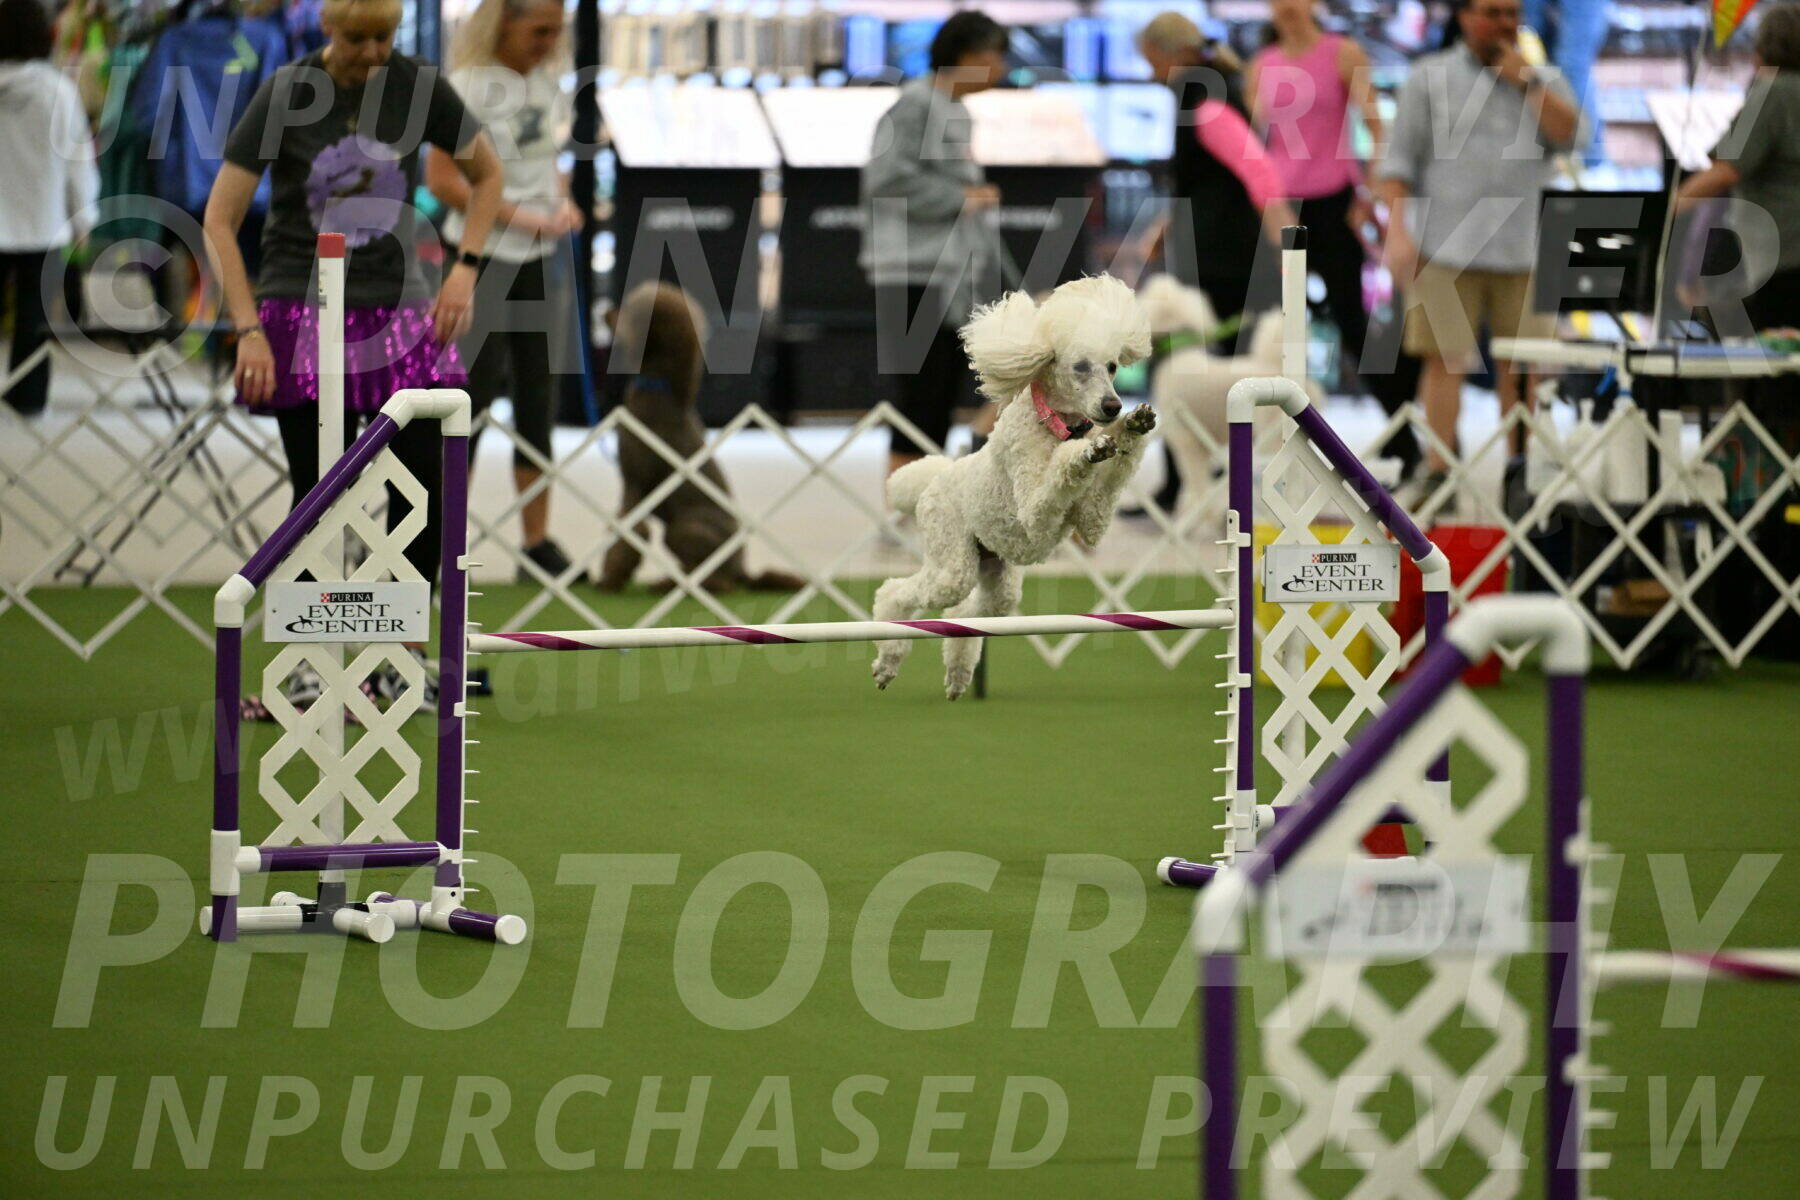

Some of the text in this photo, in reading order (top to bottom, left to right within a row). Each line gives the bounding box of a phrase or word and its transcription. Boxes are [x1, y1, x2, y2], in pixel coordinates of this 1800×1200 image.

[1319, 553, 1357, 563] PURINA
[1301, 564, 1372, 578] EVENT
[1281, 578, 1385, 592] CENTER
[329, 592, 373, 602] PURINA
[307, 603, 391, 619] EVENT
[285, 619, 407, 634] CENTER
